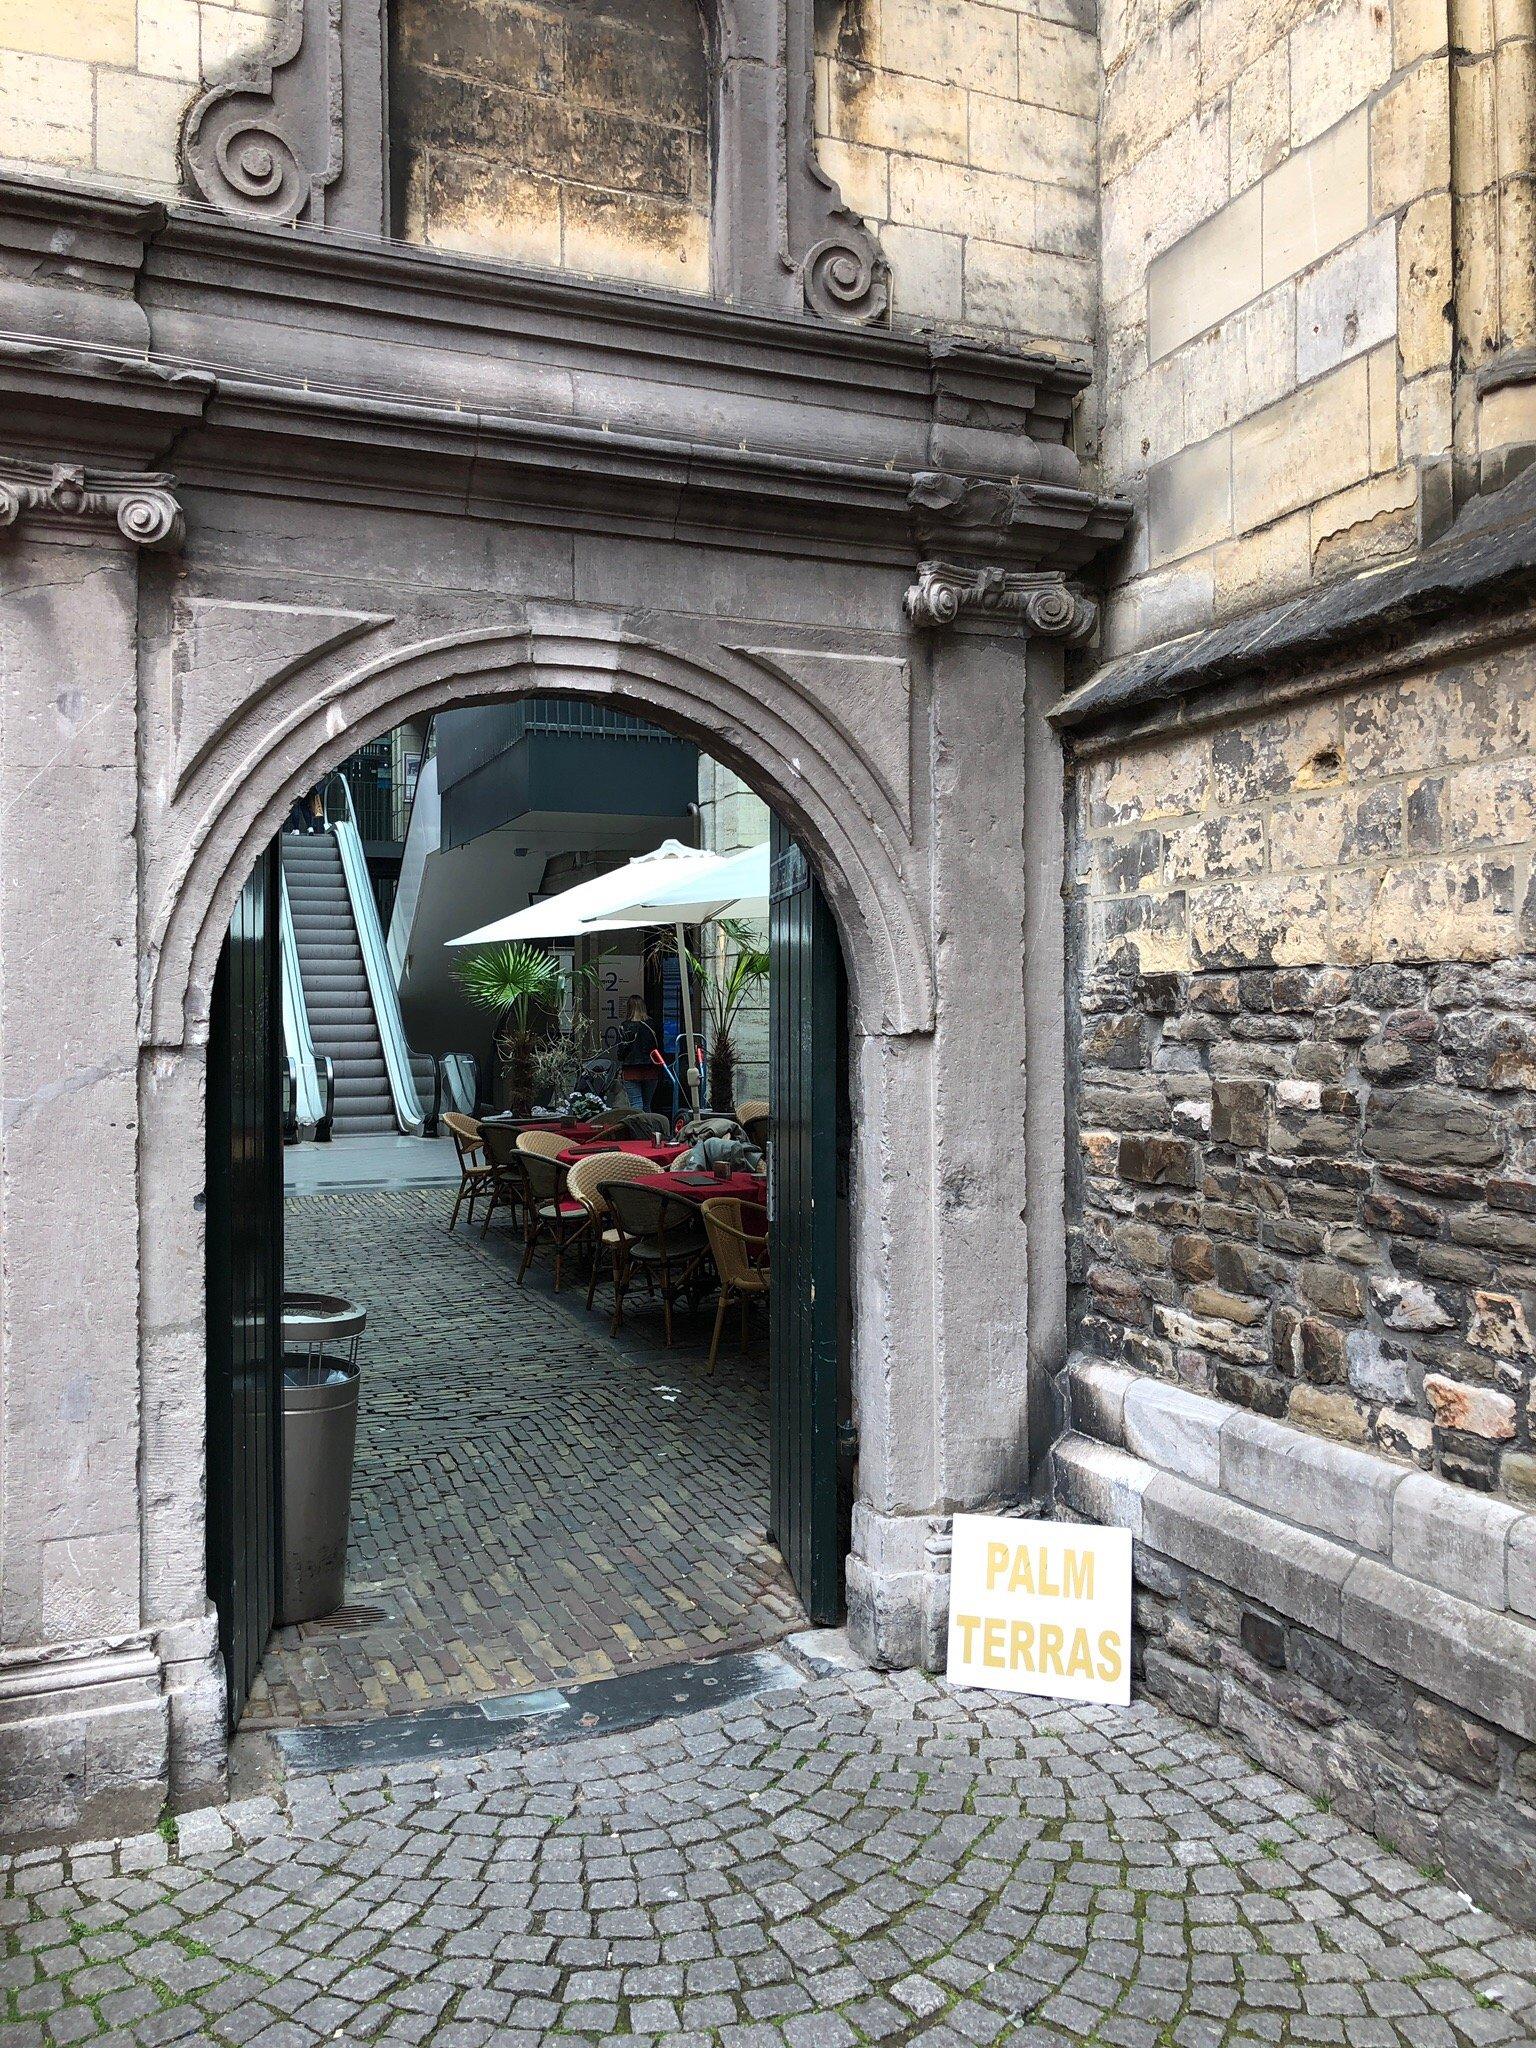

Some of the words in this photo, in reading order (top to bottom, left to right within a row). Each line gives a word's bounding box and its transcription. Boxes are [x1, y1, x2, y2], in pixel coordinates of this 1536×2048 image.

[605, 972, 619, 992] 2
[606, 999, 618, 1019] 1
[605, 1026, 620, 1048] 0
[987, 1542, 1095, 1600] PALM
[956, 1614, 1122, 1682] TERRAS
